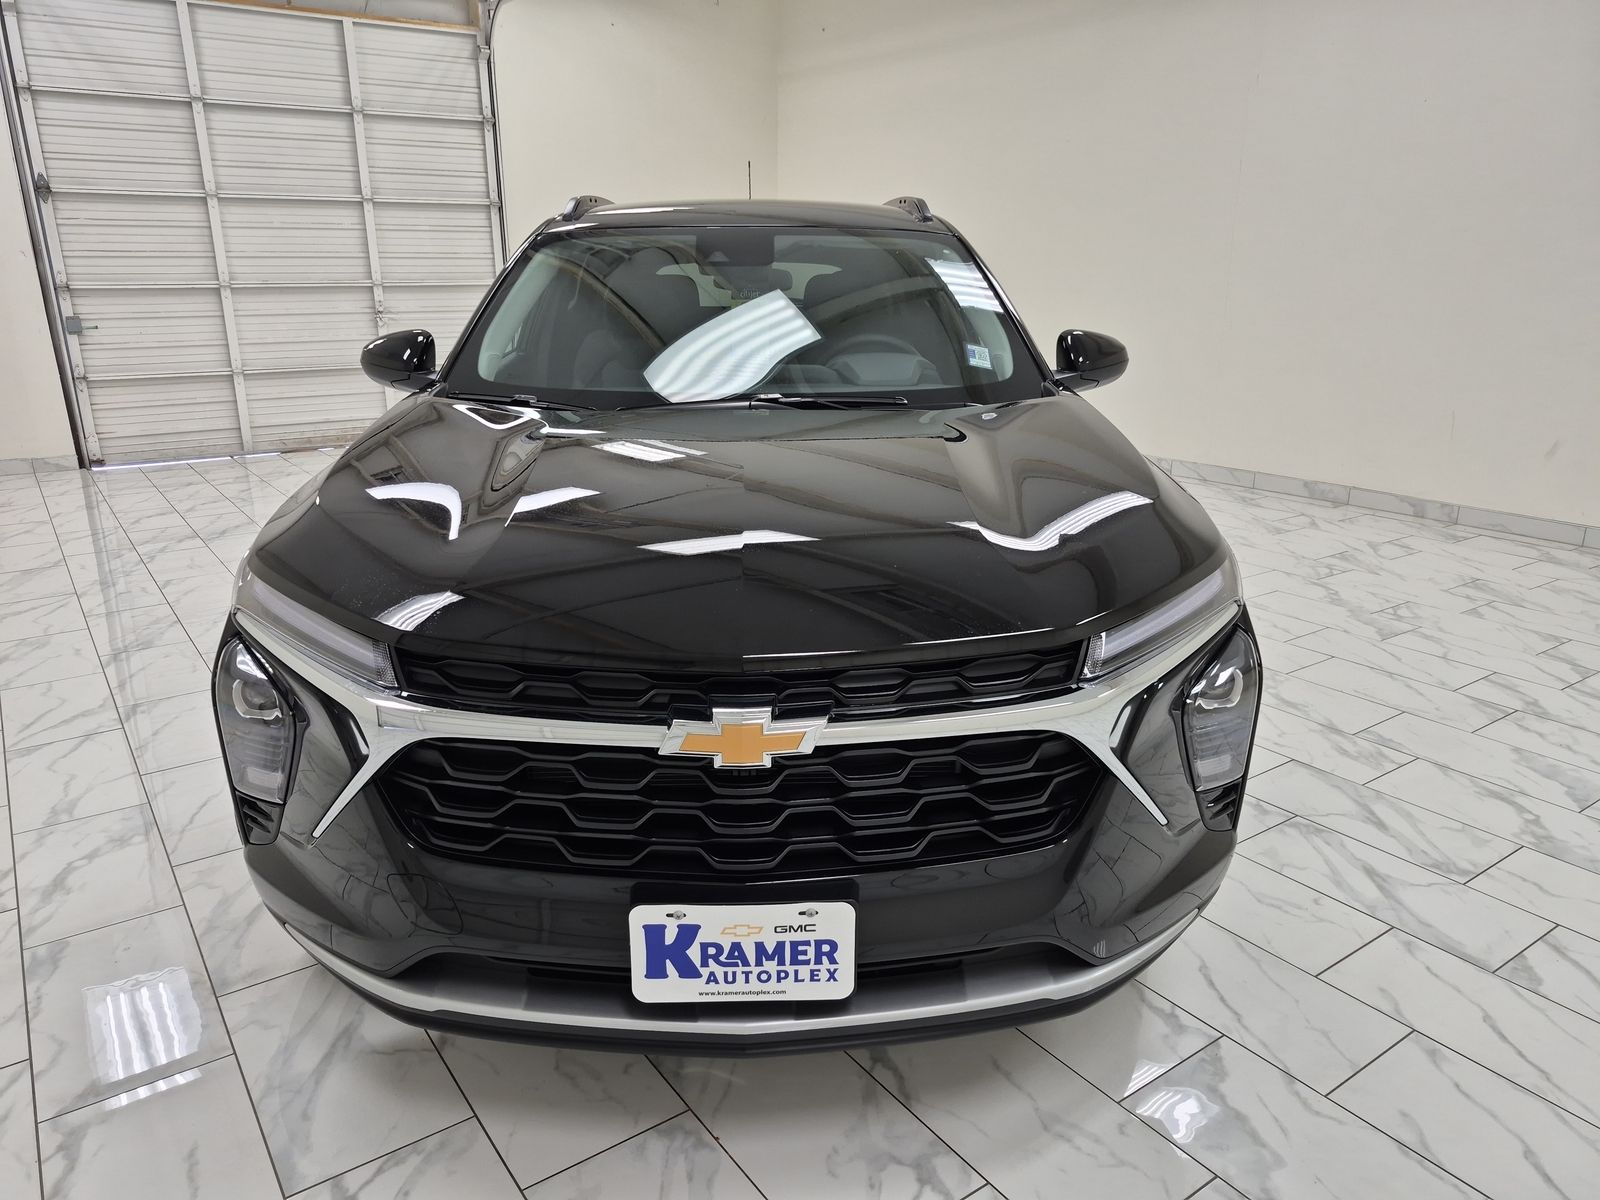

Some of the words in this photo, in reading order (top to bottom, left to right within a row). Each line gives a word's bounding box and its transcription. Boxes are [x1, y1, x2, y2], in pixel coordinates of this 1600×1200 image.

[774, 923, 817, 934] GMC
[642, 923, 839, 979] KRAMER
[705, 968, 839, 985] AUTOPLEX
[698, 989, 787, 997] www.kramerautoplex.com
